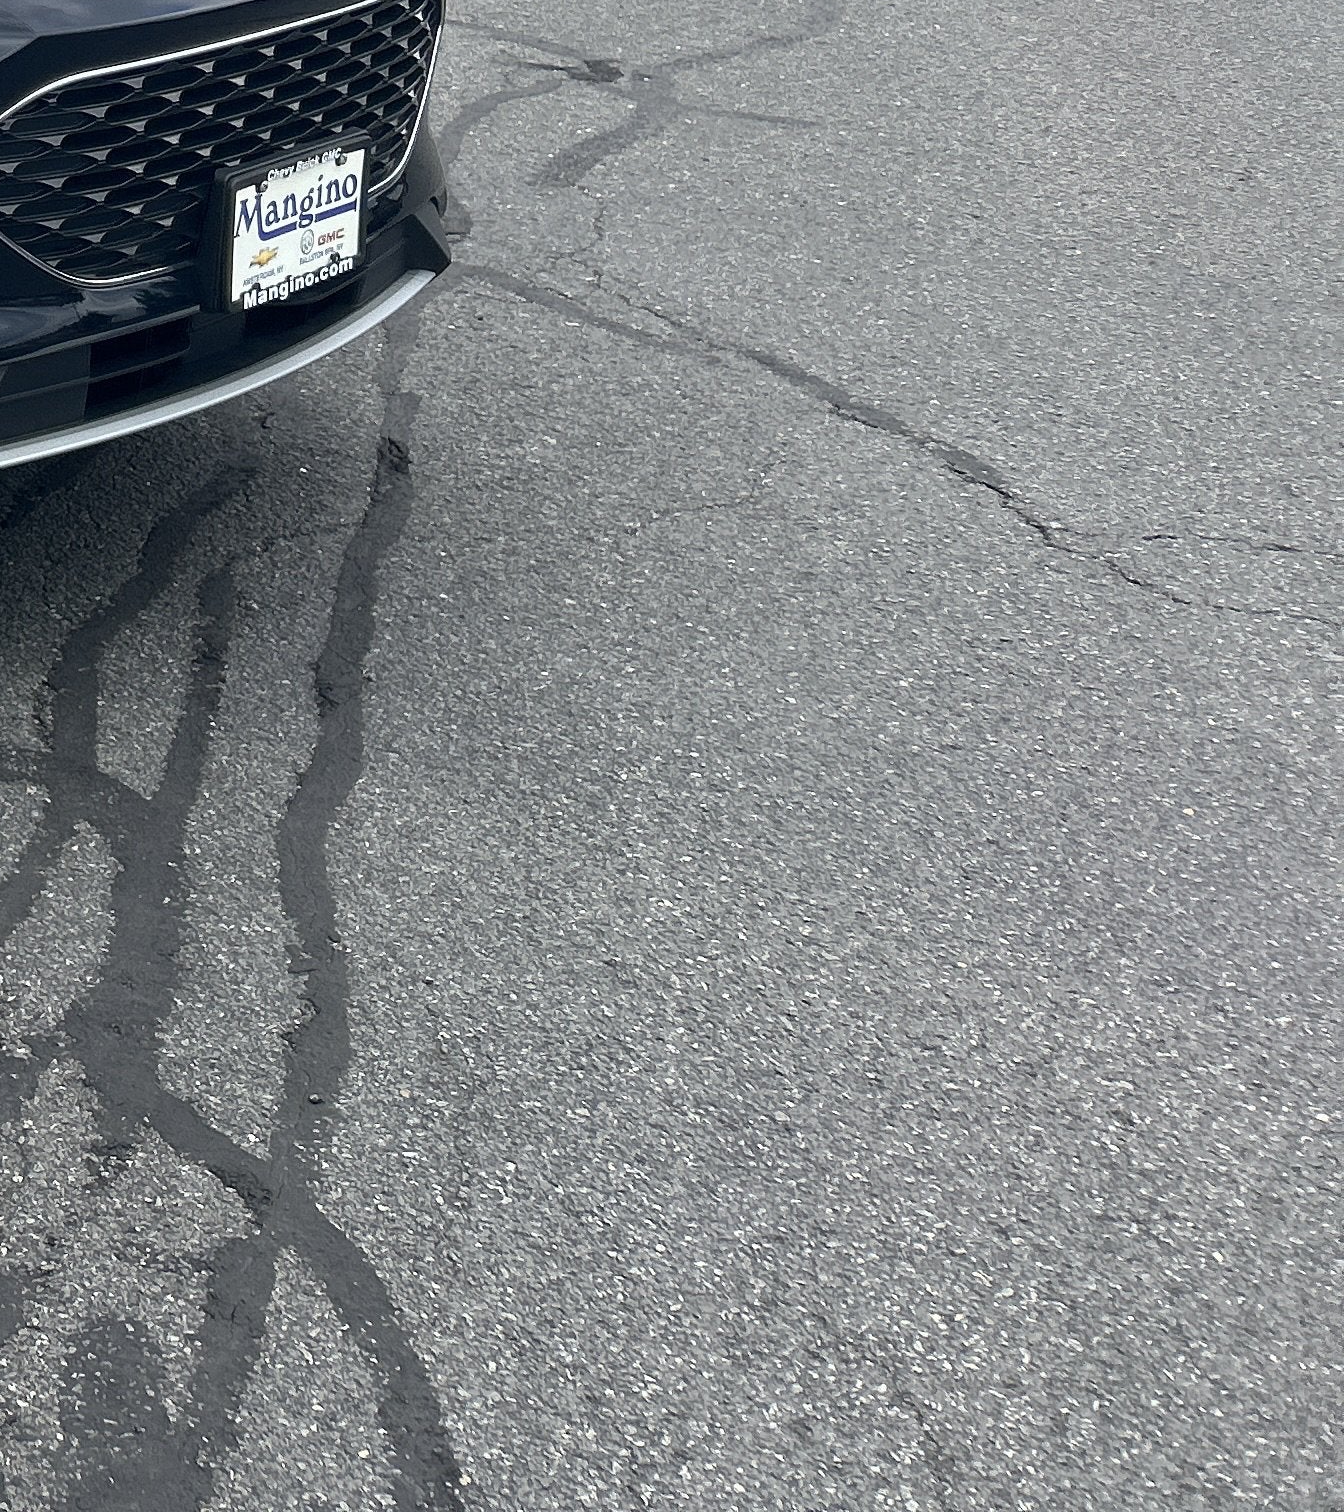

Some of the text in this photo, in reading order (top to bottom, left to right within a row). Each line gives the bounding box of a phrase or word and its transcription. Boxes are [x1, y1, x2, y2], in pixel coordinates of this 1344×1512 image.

[234, 173, 358, 240] Mangino
[318, 227, 345, 245] GMC
[243, 257, 354, 310] Mangino.com
